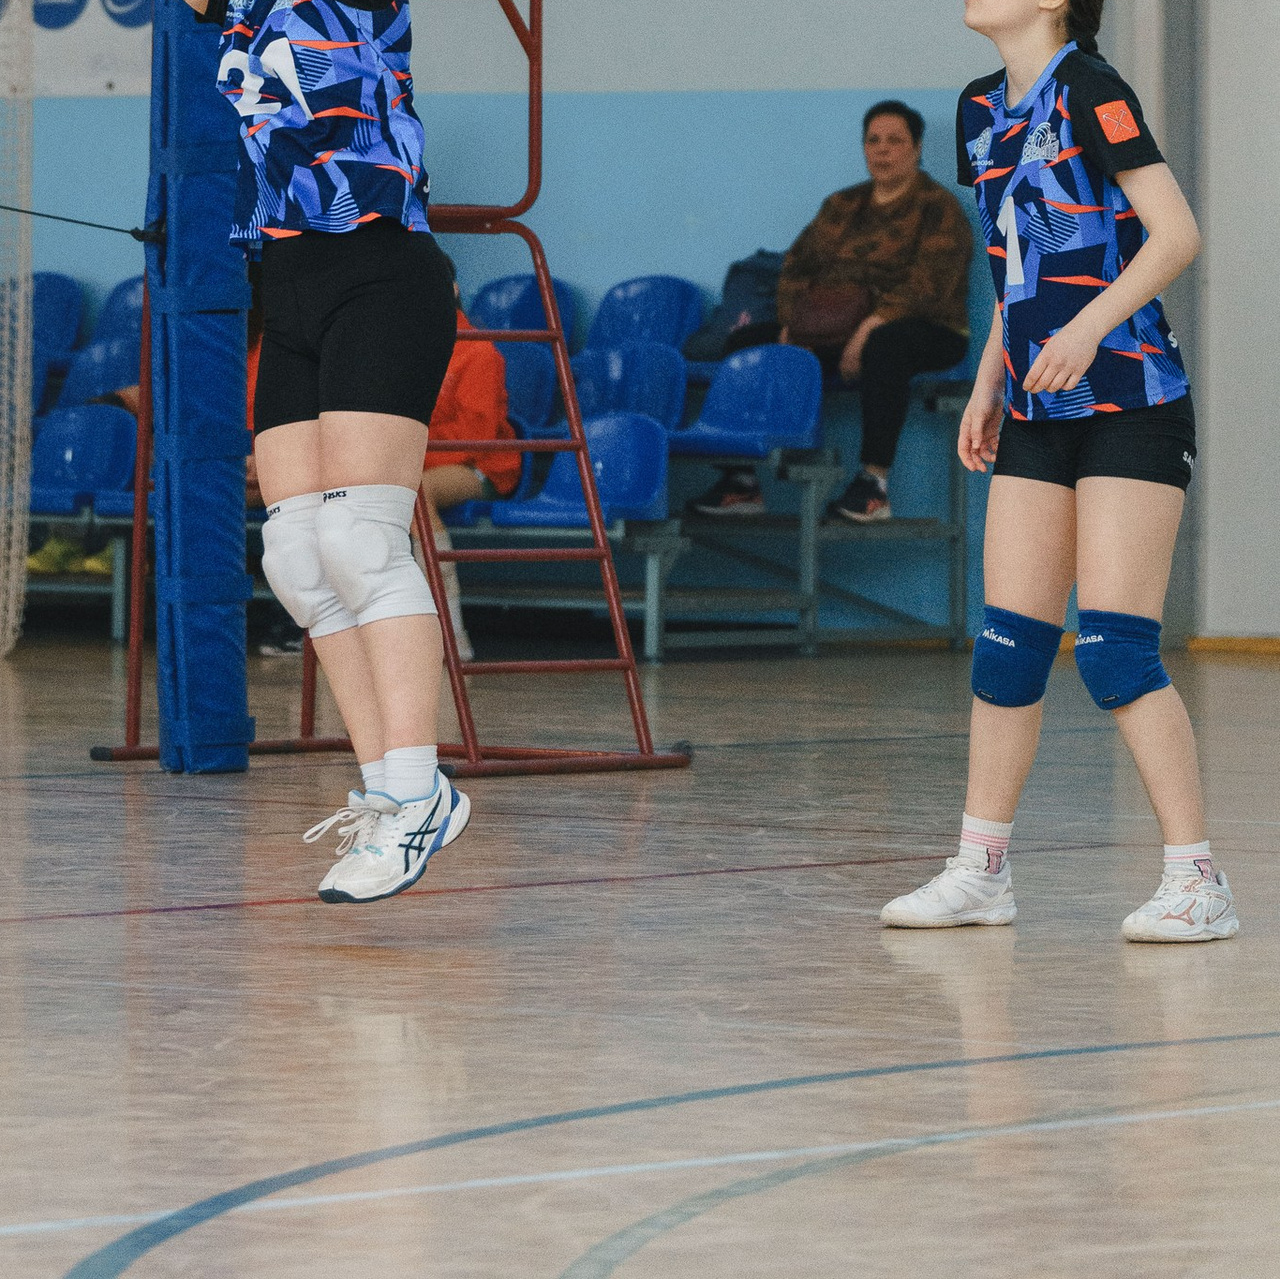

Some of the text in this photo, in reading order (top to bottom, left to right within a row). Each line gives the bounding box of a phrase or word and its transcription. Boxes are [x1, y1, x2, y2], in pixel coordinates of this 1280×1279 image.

[217, 37, 315, 120] 21
[996, 195, 1025, 286] 1
[982, 628, 1015, 648] MIKASA
